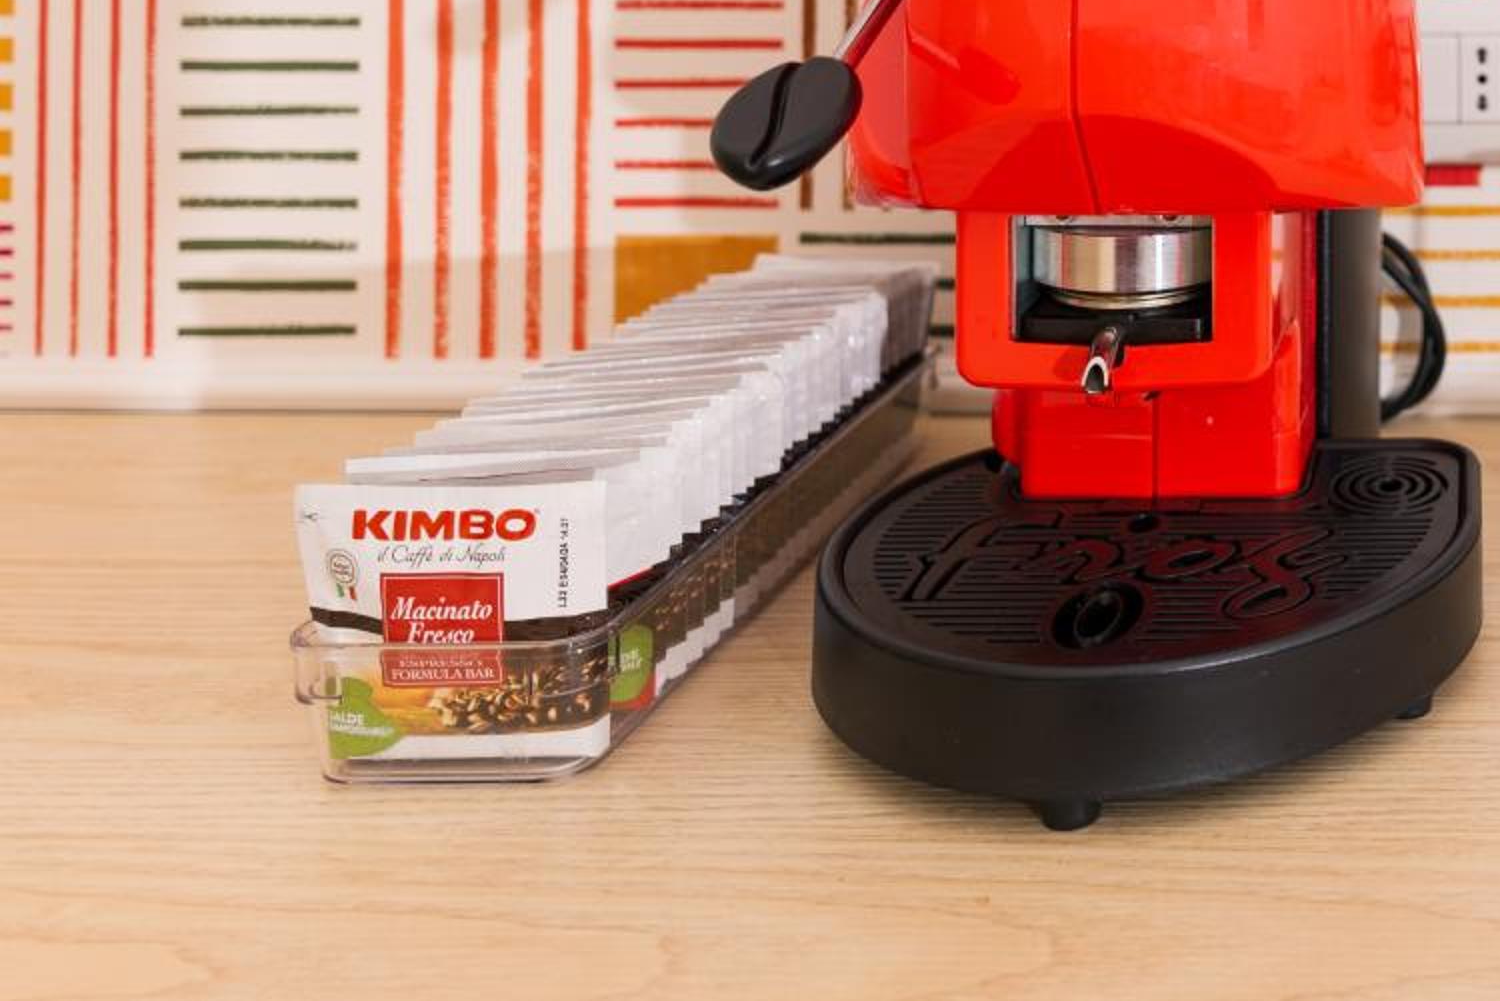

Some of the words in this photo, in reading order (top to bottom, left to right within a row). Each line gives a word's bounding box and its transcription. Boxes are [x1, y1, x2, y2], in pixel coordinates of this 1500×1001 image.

[351, 509, 537, 542] KIMBO
[390, 596, 493, 620] Macinato
[407, 621, 476, 645] Fresco
[391, 668, 463, 680] FORMULA
[464, 667, 495, 679] BAR
